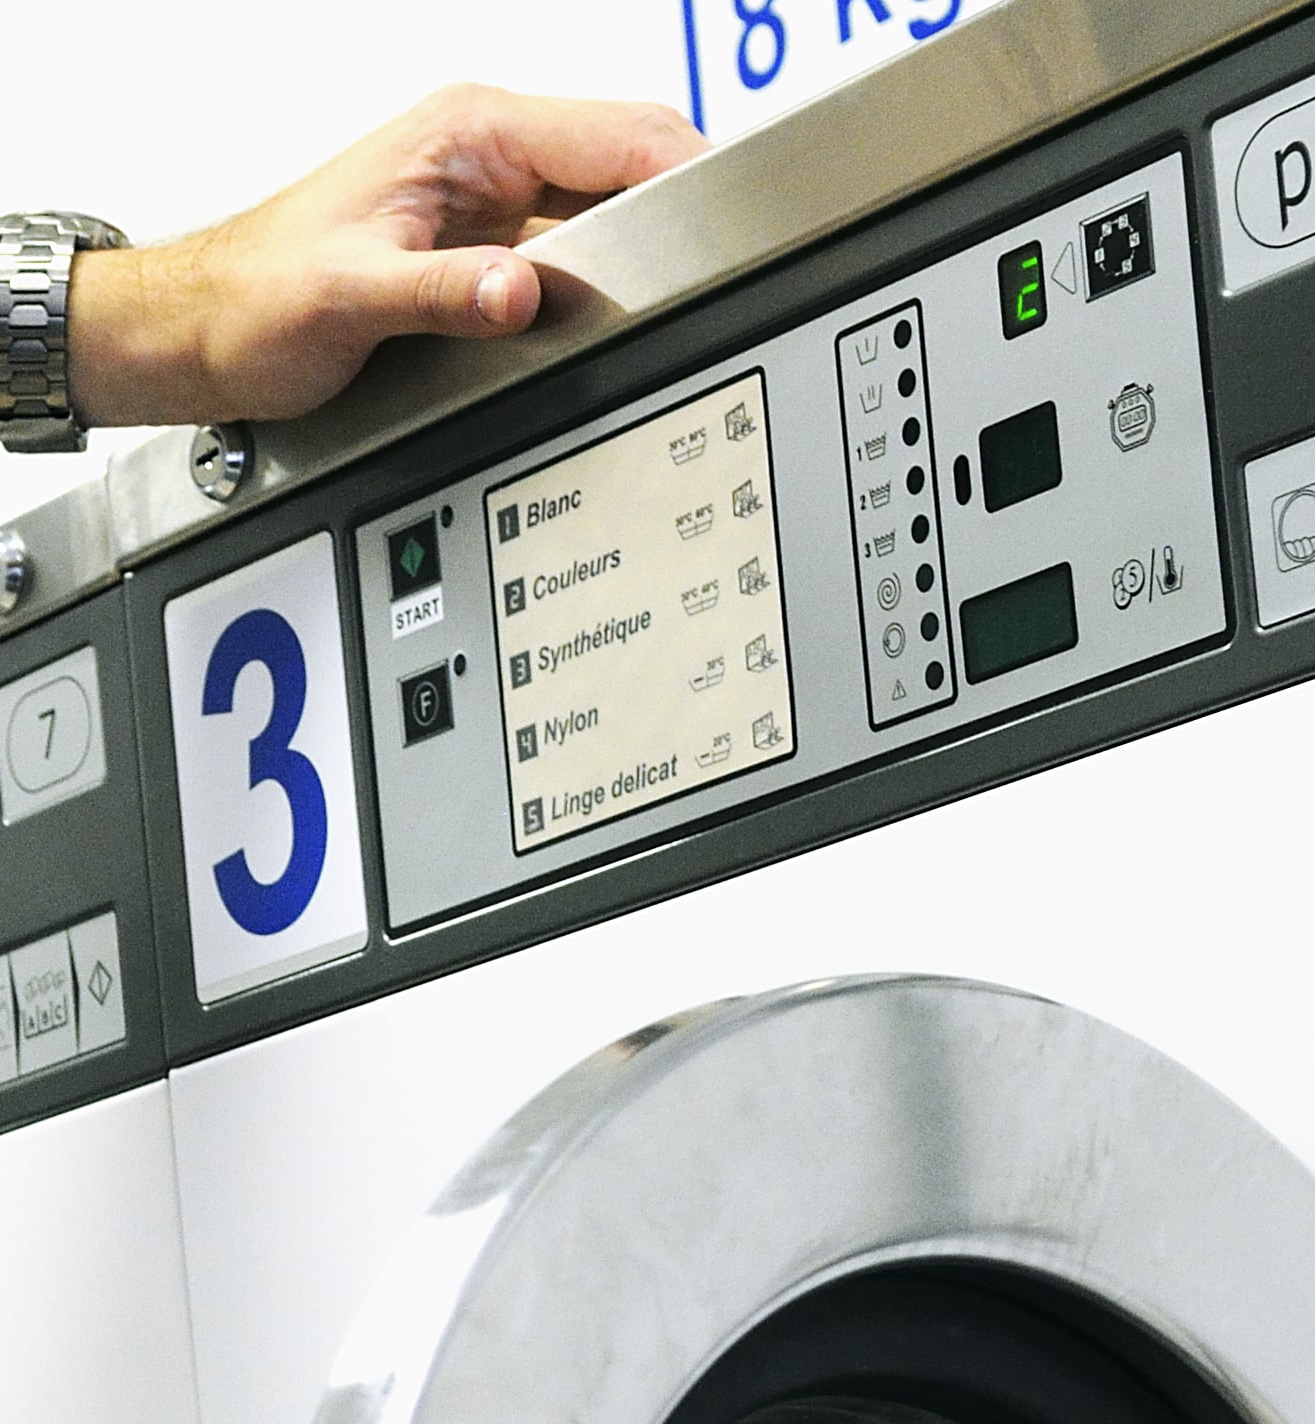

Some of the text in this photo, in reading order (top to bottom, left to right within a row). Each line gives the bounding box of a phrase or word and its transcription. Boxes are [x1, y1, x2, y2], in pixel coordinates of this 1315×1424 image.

[735, 0, 786, 89] 8
[1017, 257, 1039, 321] 2
[527, 489, 582, 528] Blanc
[860, 495, 867, 510] 2
[533, 549, 621, 600] Couleurs
[865, 543, 872, 558] 3
[396, 598, 441, 629] START
[538, 610, 652, 673] Synthétique
[544, 707, 598, 746] Nylon
[202, 608, 328, 935] 3
[552, 785, 605, 821] Linge
[611, 753, 679, 798] delicat
